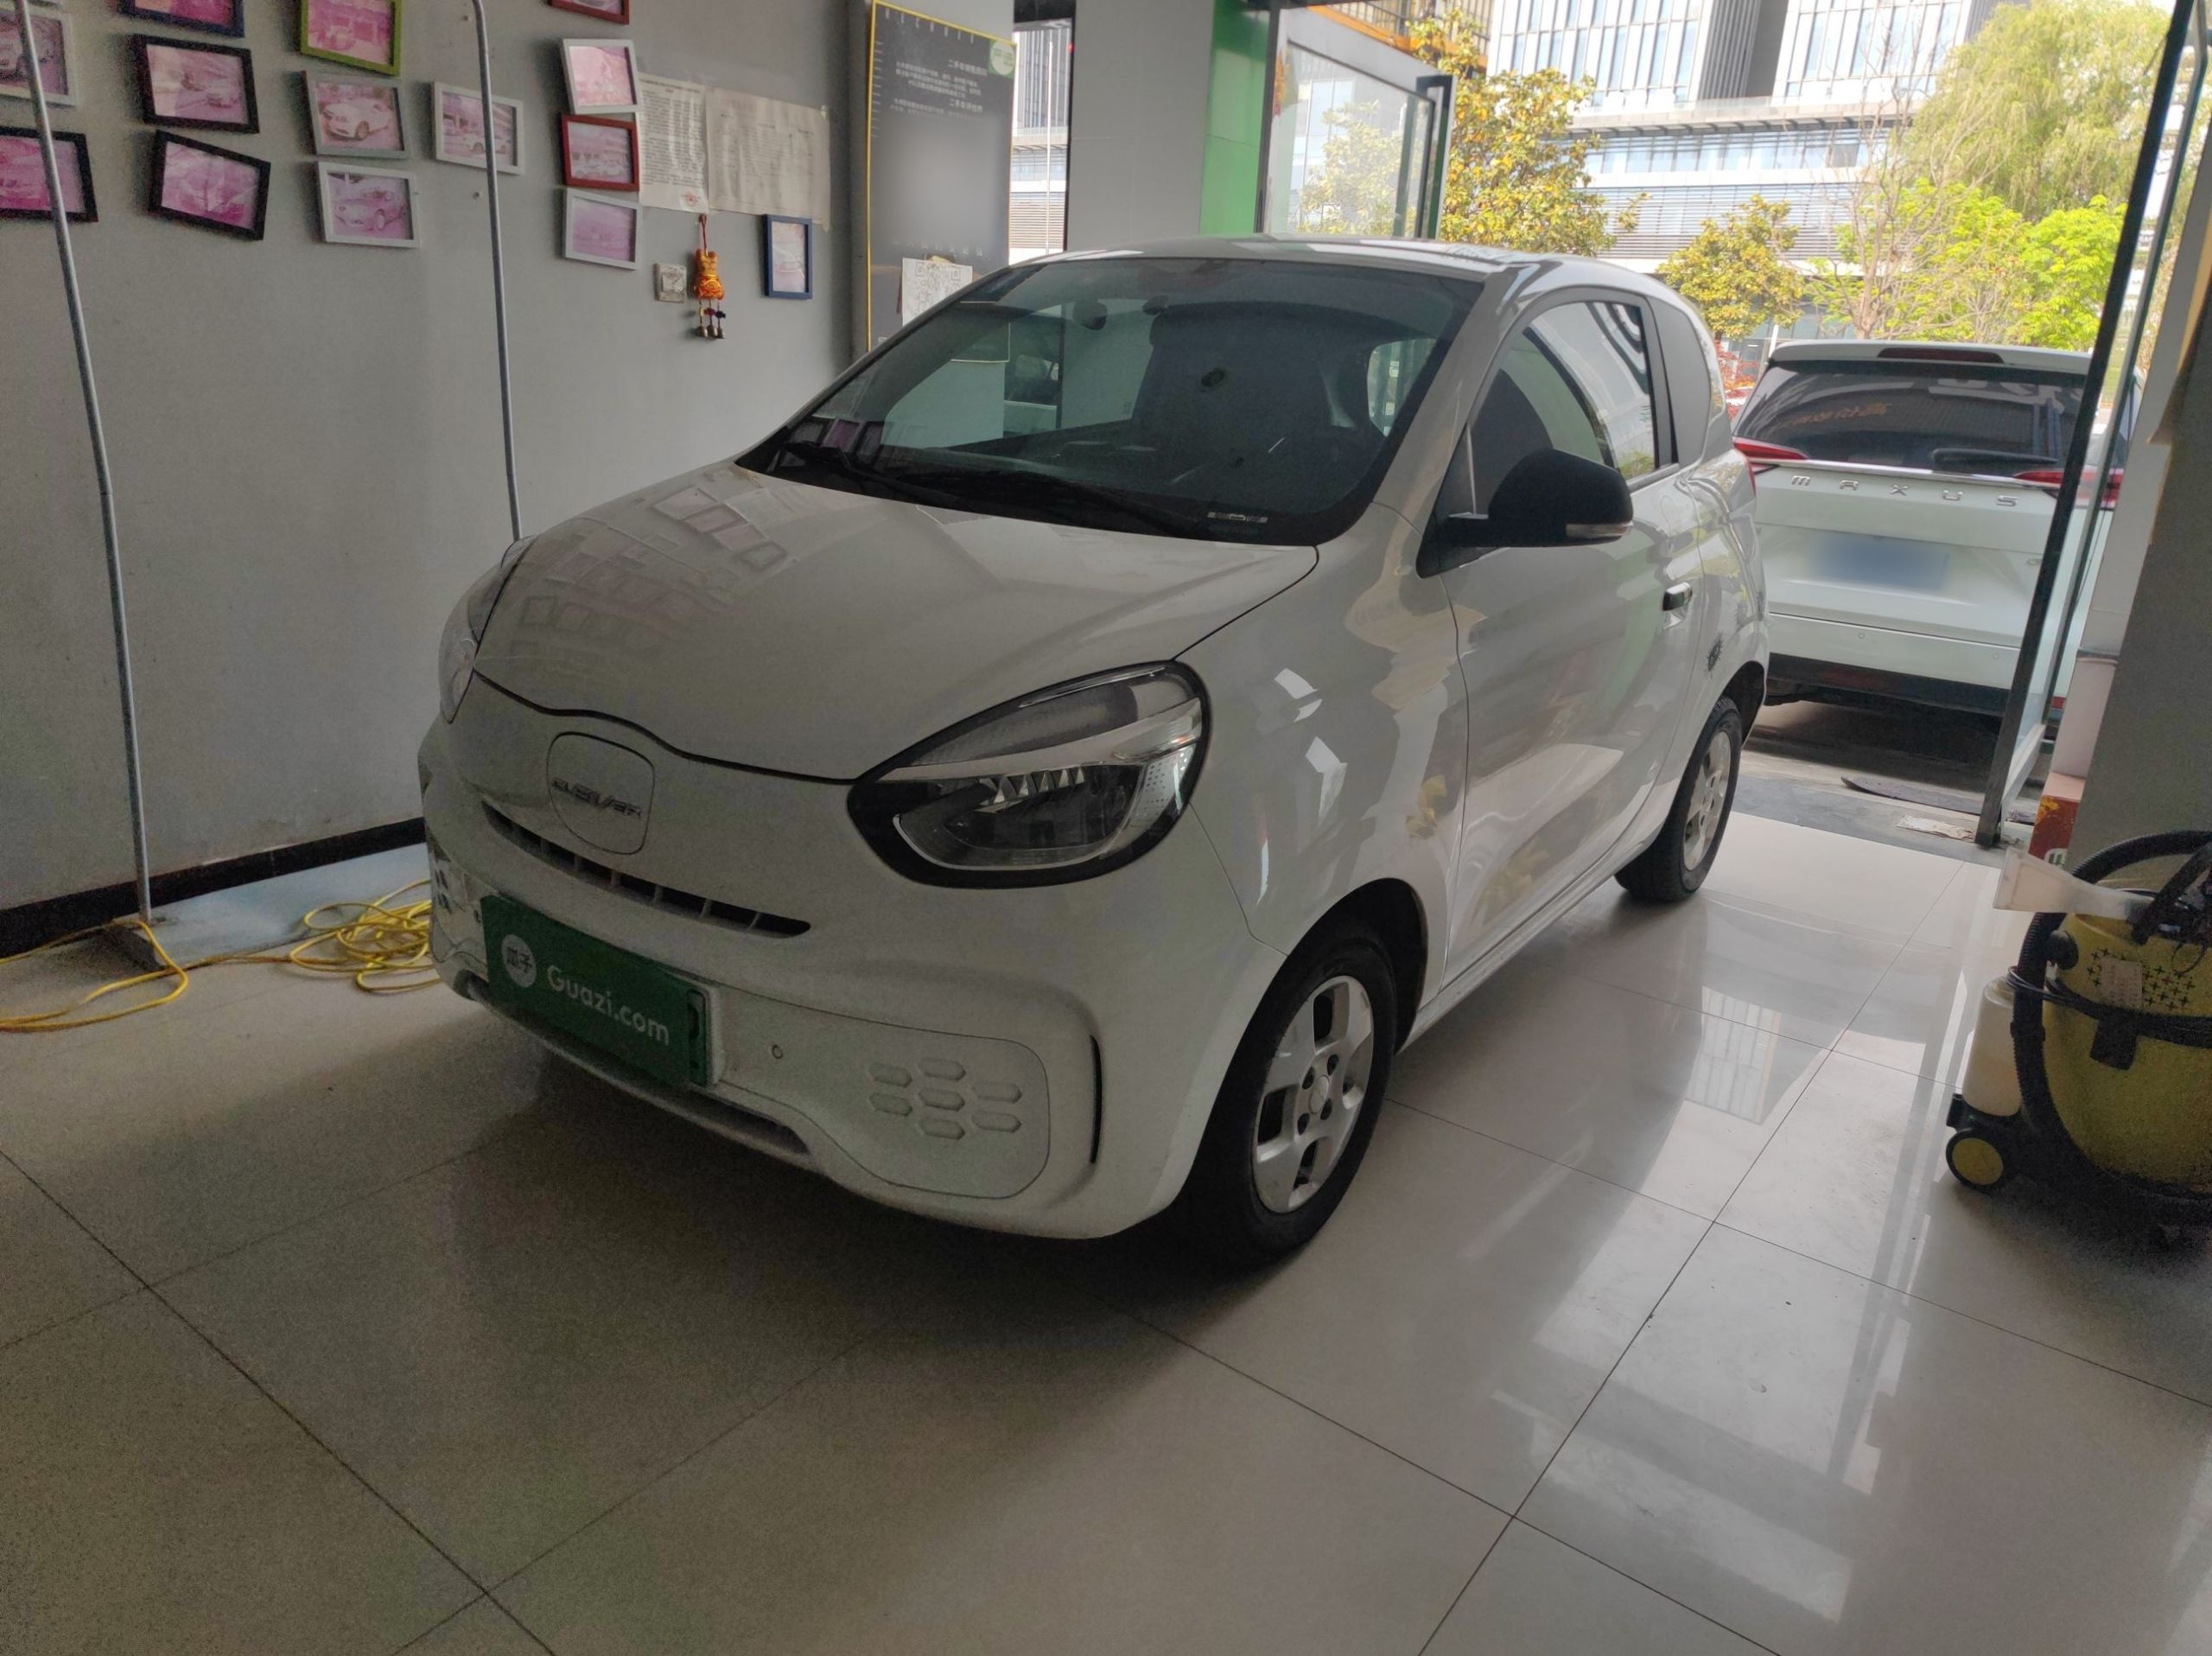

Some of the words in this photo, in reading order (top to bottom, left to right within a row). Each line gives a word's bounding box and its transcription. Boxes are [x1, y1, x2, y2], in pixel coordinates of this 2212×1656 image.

[1790, 475, 2019, 507] MAXUS
[506, 946, 533, 973] 瓜子
[547, 965, 669, 1046] Guazi.com
